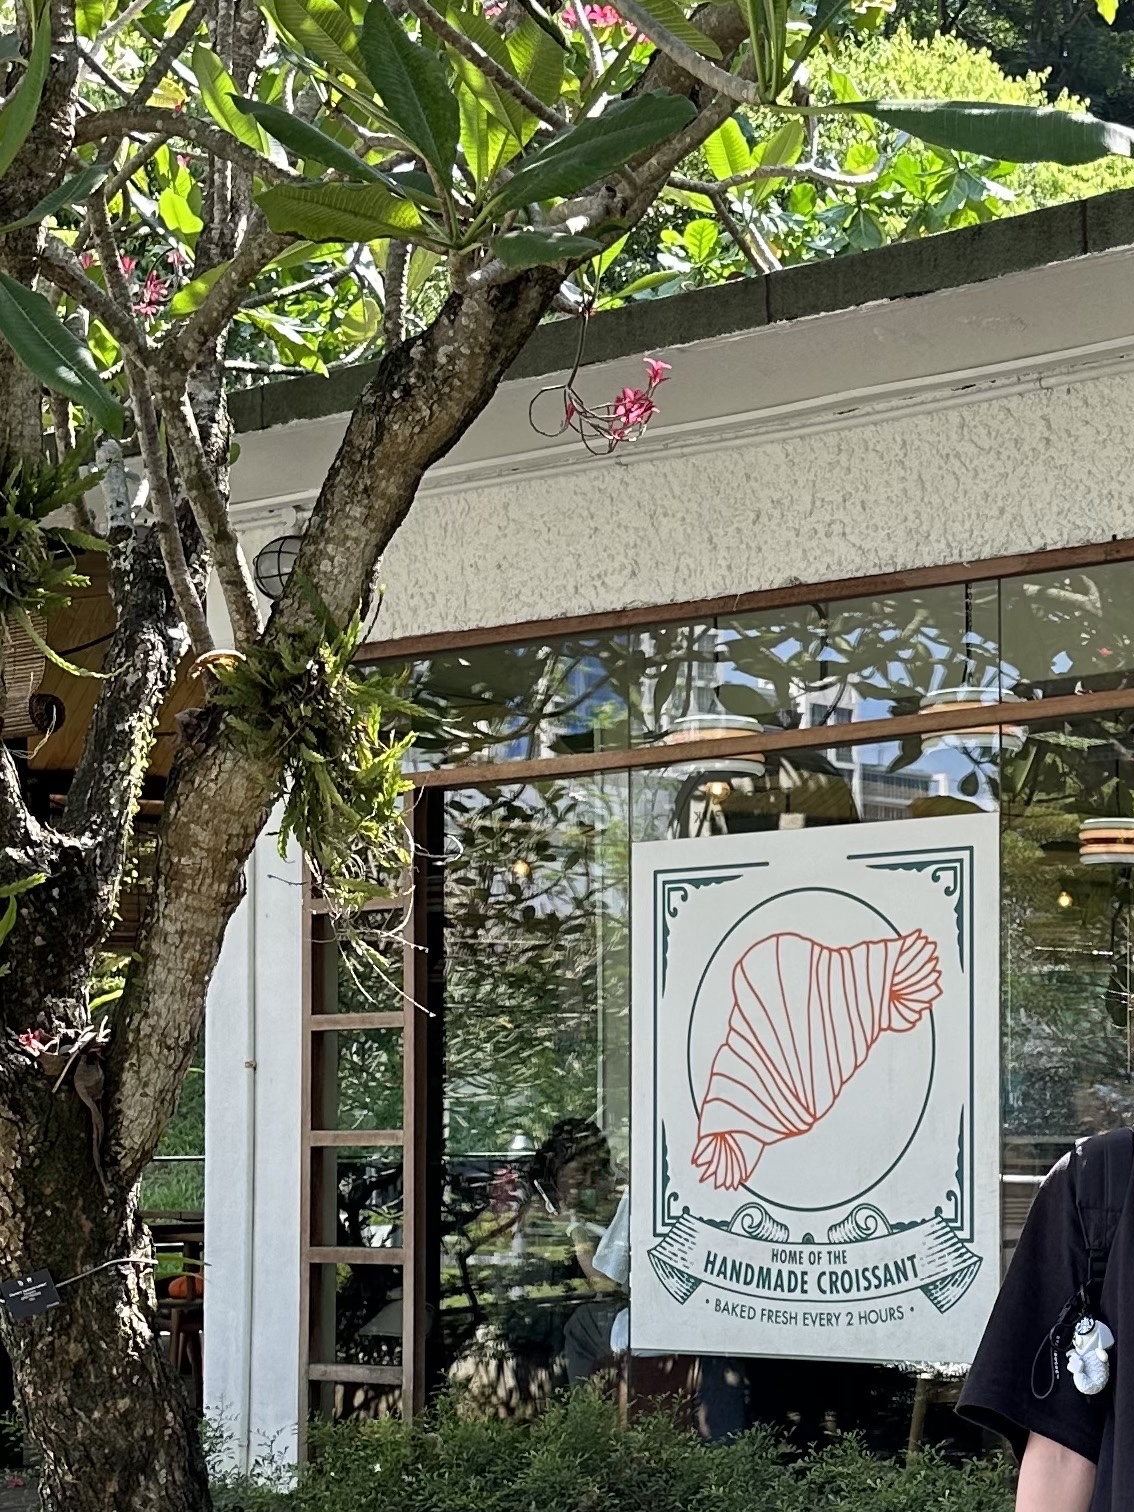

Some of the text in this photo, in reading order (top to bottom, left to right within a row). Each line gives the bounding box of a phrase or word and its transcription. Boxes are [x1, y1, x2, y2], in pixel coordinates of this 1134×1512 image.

[771, 1248, 848, 1266] HOME OF THE
[703, 1250, 919, 1295] HANDMADE CROISSANT
[714, 1297, 905, 1327] BAKED FRESH EVERY 2 HOURS
